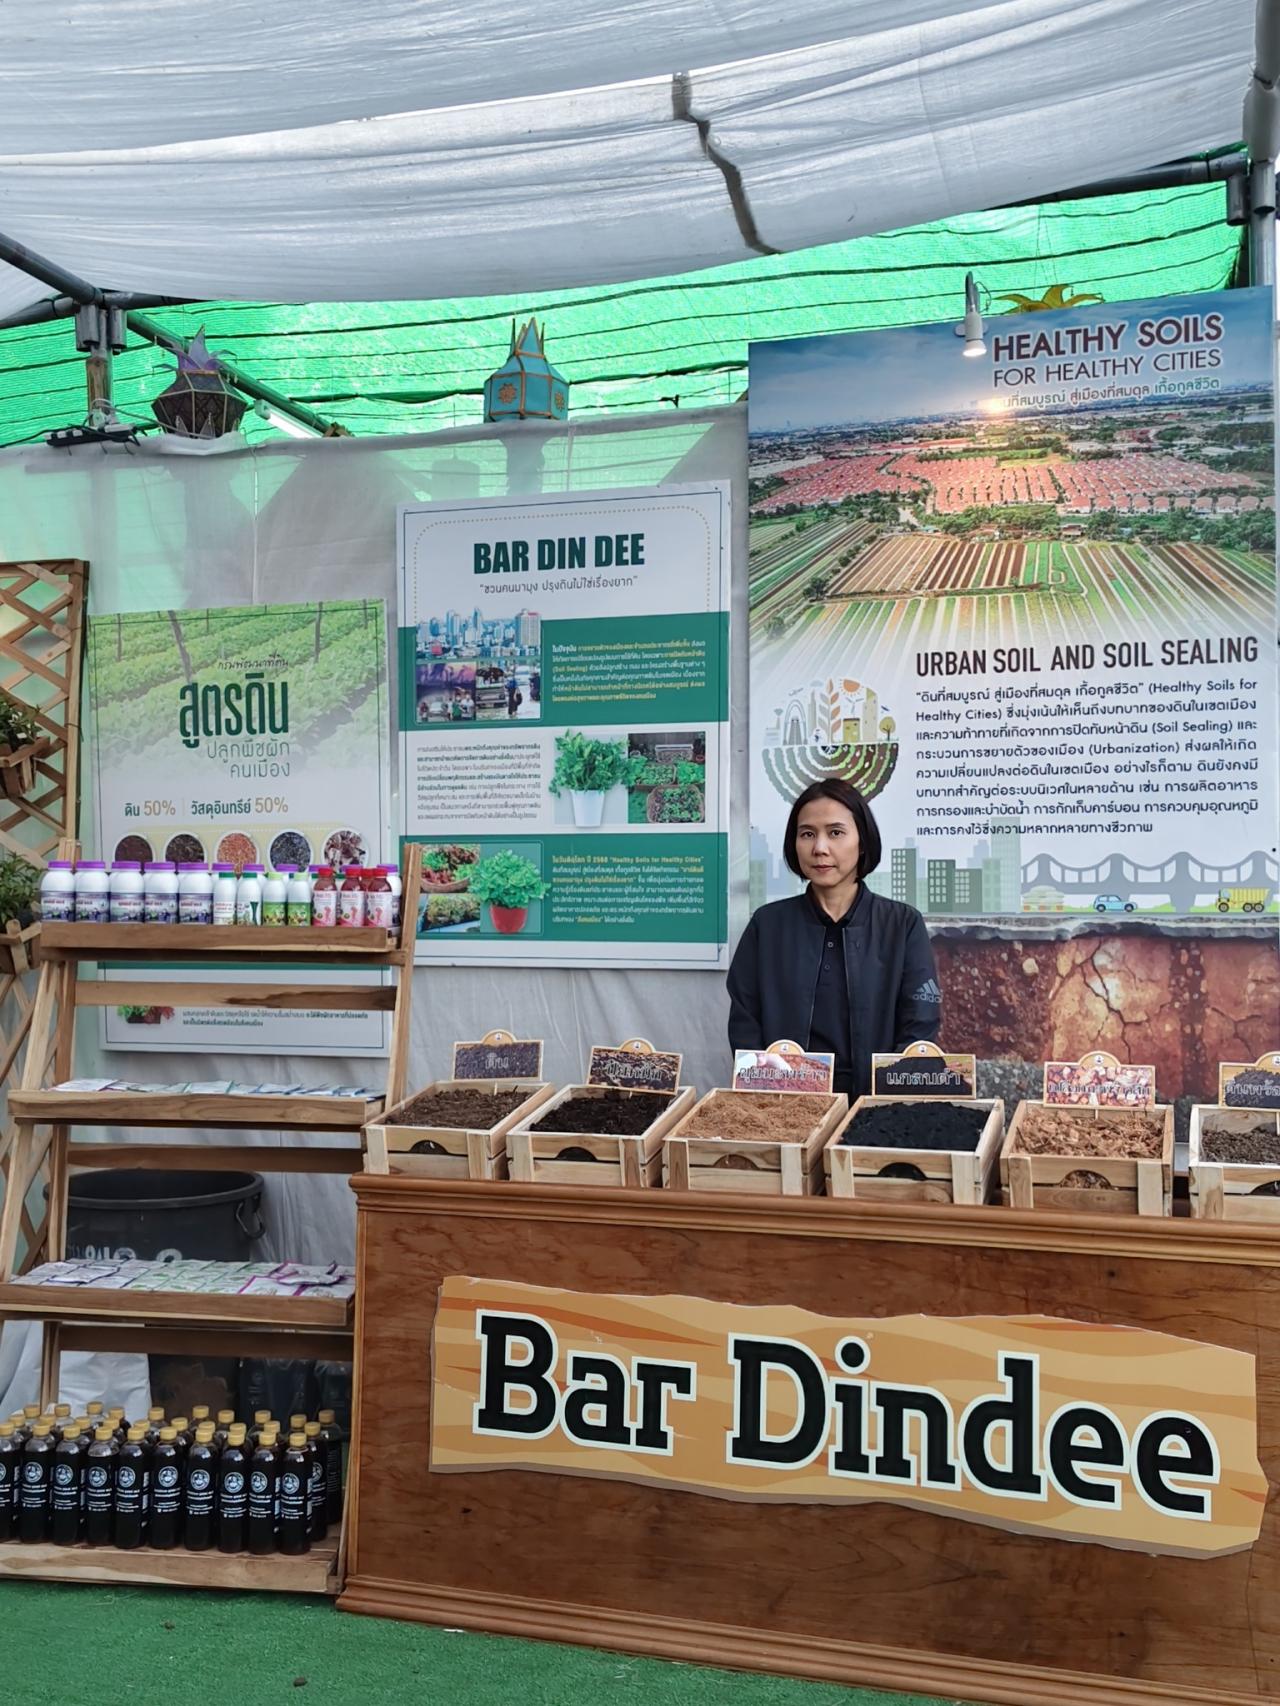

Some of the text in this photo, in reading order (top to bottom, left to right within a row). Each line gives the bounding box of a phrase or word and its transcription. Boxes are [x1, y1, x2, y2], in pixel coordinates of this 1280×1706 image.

[993, 314, 1223, 362] HEALTHY SOILS
[993, 349, 1221, 388] FOR HEALTHY CITIES
[1070, 381, 1150, 406] สู่เมืองที่สมดุล
[1154, 375, 1219, 396] เกื้อกูลชีวิต
[473, 533, 645, 574] BAR DIN DEE
[916, 636, 1258, 677] URBAN SOIL AND SOIL SEALING
[994, 682, 1071, 703] สู่เมืองที่สมดุล
[1148, 681, 1202, 695] (Healthy
[1206, 679, 1235, 691] Soils
[1239, 678, 1257, 690] for
[179, 672, 289, 748] สูตรดิน
[916, 709, 961, 723] Healthy
[965, 708, 1003, 720] Cities)
[1152, 721, 1178, 735] (Soil
[1182, 719, 1233, 734] Sealing)
[1237, 720, 1257, 730] และ
[207, 738, 290, 763] ปลูกพืชผัก
[1088, 742, 1180, 756] (Urbanization)
[230, 758, 290, 779] คนเมือง
[1197, 757, 1258, 771] ดินยังคงมี
[1139, 780, 1159, 793] เช่น
[1164, 780, 1258, 793] การผลิตอาหาร
[124, 802, 140, 816] ดิน
[143, 799, 176, 816] 50%
[255, 797, 289, 814] 50%
[472, 1308, 1221, 1520] Bar Dindee
